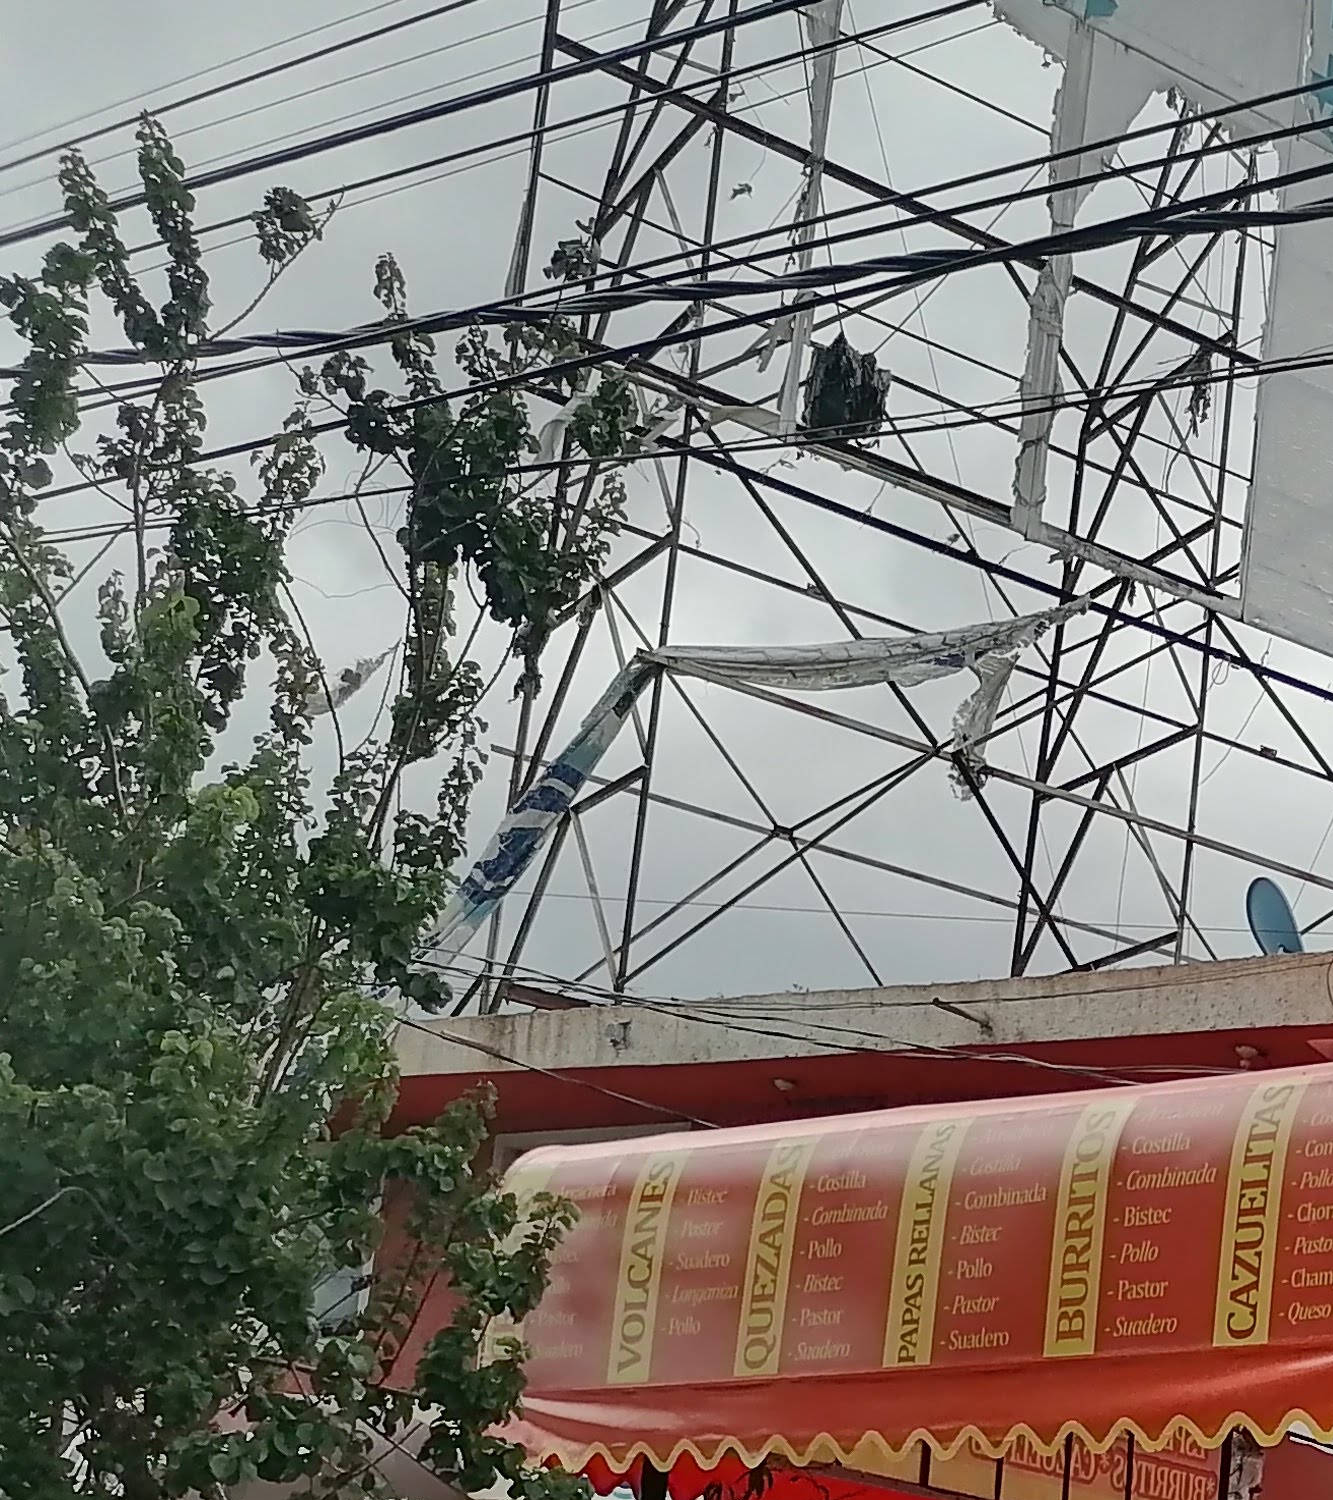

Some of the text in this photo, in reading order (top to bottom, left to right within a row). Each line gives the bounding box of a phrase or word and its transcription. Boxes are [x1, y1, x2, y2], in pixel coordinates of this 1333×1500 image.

[1126, 1163, 1217, 1192] Combinada
[964, 1183, 1047, 1210] Combinada
[1124, 1206, 1173, 1227] Bistec
[1226, 1084, 1294, 1340] CAZUELITAS
[959, 1224, 1002, 1245] Bistec
[1056, 1109, 1115, 1343] BURRITOS
[808, 1240, 842, 1259] Pollo
[897, 1123, 957, 1364] PAPAS RELLANAS
[1120, 1240, 1159, 1265] Pollo
[617, 1160, 675, 1373] VOLCANES
[744, 1144, 802, 1369] QUEZADAS
[956, 1258, 992, 1280] Pollo
[1118, 1278, 1169, 1300] Pastor
[952, 1293, 1000, 1315] Pastor
[1288, 1301, 1331, 1326] Queso
[1112, 1314, 1178, 1339] Suadero
[949, 1328, 1009, 1351] Suadero
